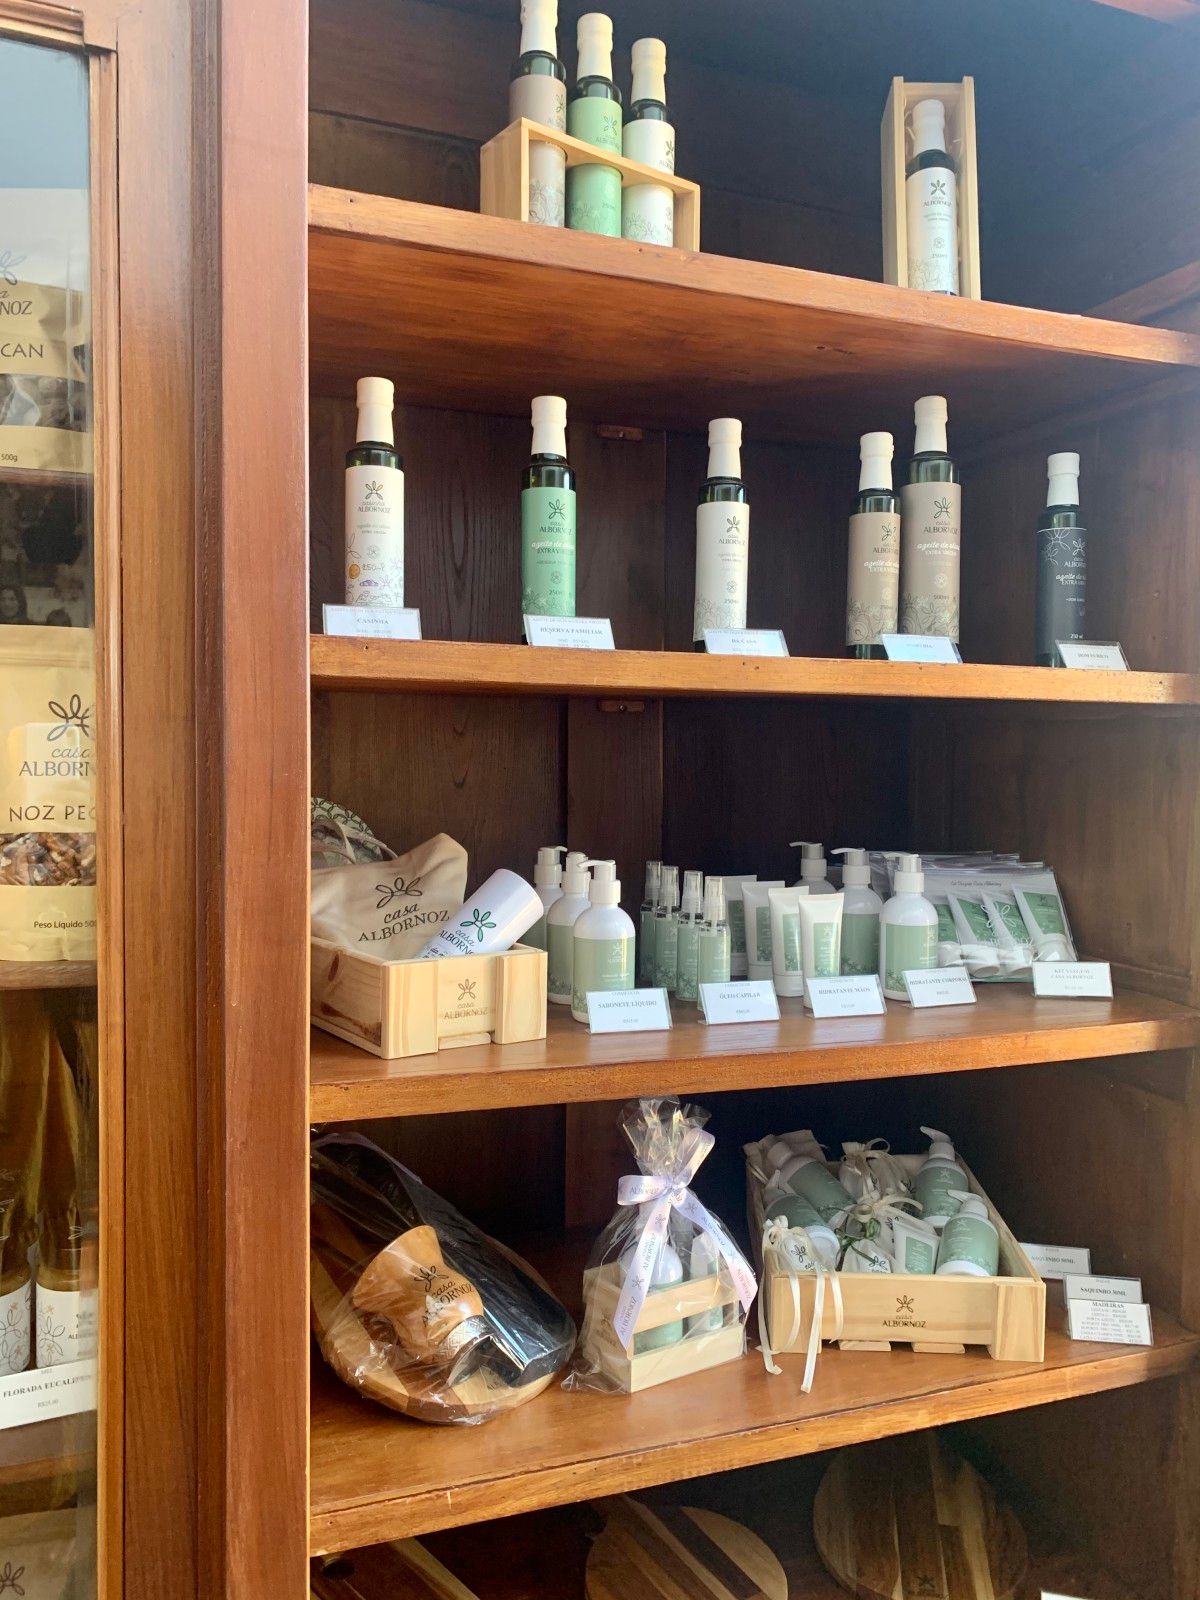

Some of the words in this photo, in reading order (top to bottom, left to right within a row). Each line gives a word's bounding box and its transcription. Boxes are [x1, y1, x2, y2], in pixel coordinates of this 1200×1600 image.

[571, 628, 603, 636] FAMILIAR
[9, 805, 55, 822] NOZ
[384, 903, 419, 924] casa
[33, 920, 52, 930] Peso
[53, 920, 83, 931] Líquido
[358, 910, 450, 941] ALBORNOZ
[455, 929, 474, 947] casa
[597, 1001, 630, 1009] SABONETE
[444, 1006, 488, 1019] ALBORNOZ
[1080, 1287, 1111, 1295] SAQUINHO
[882, 1319, 926, 1328] ALBORNOZ
[3, 1385, 42, 1398] FLORADA
